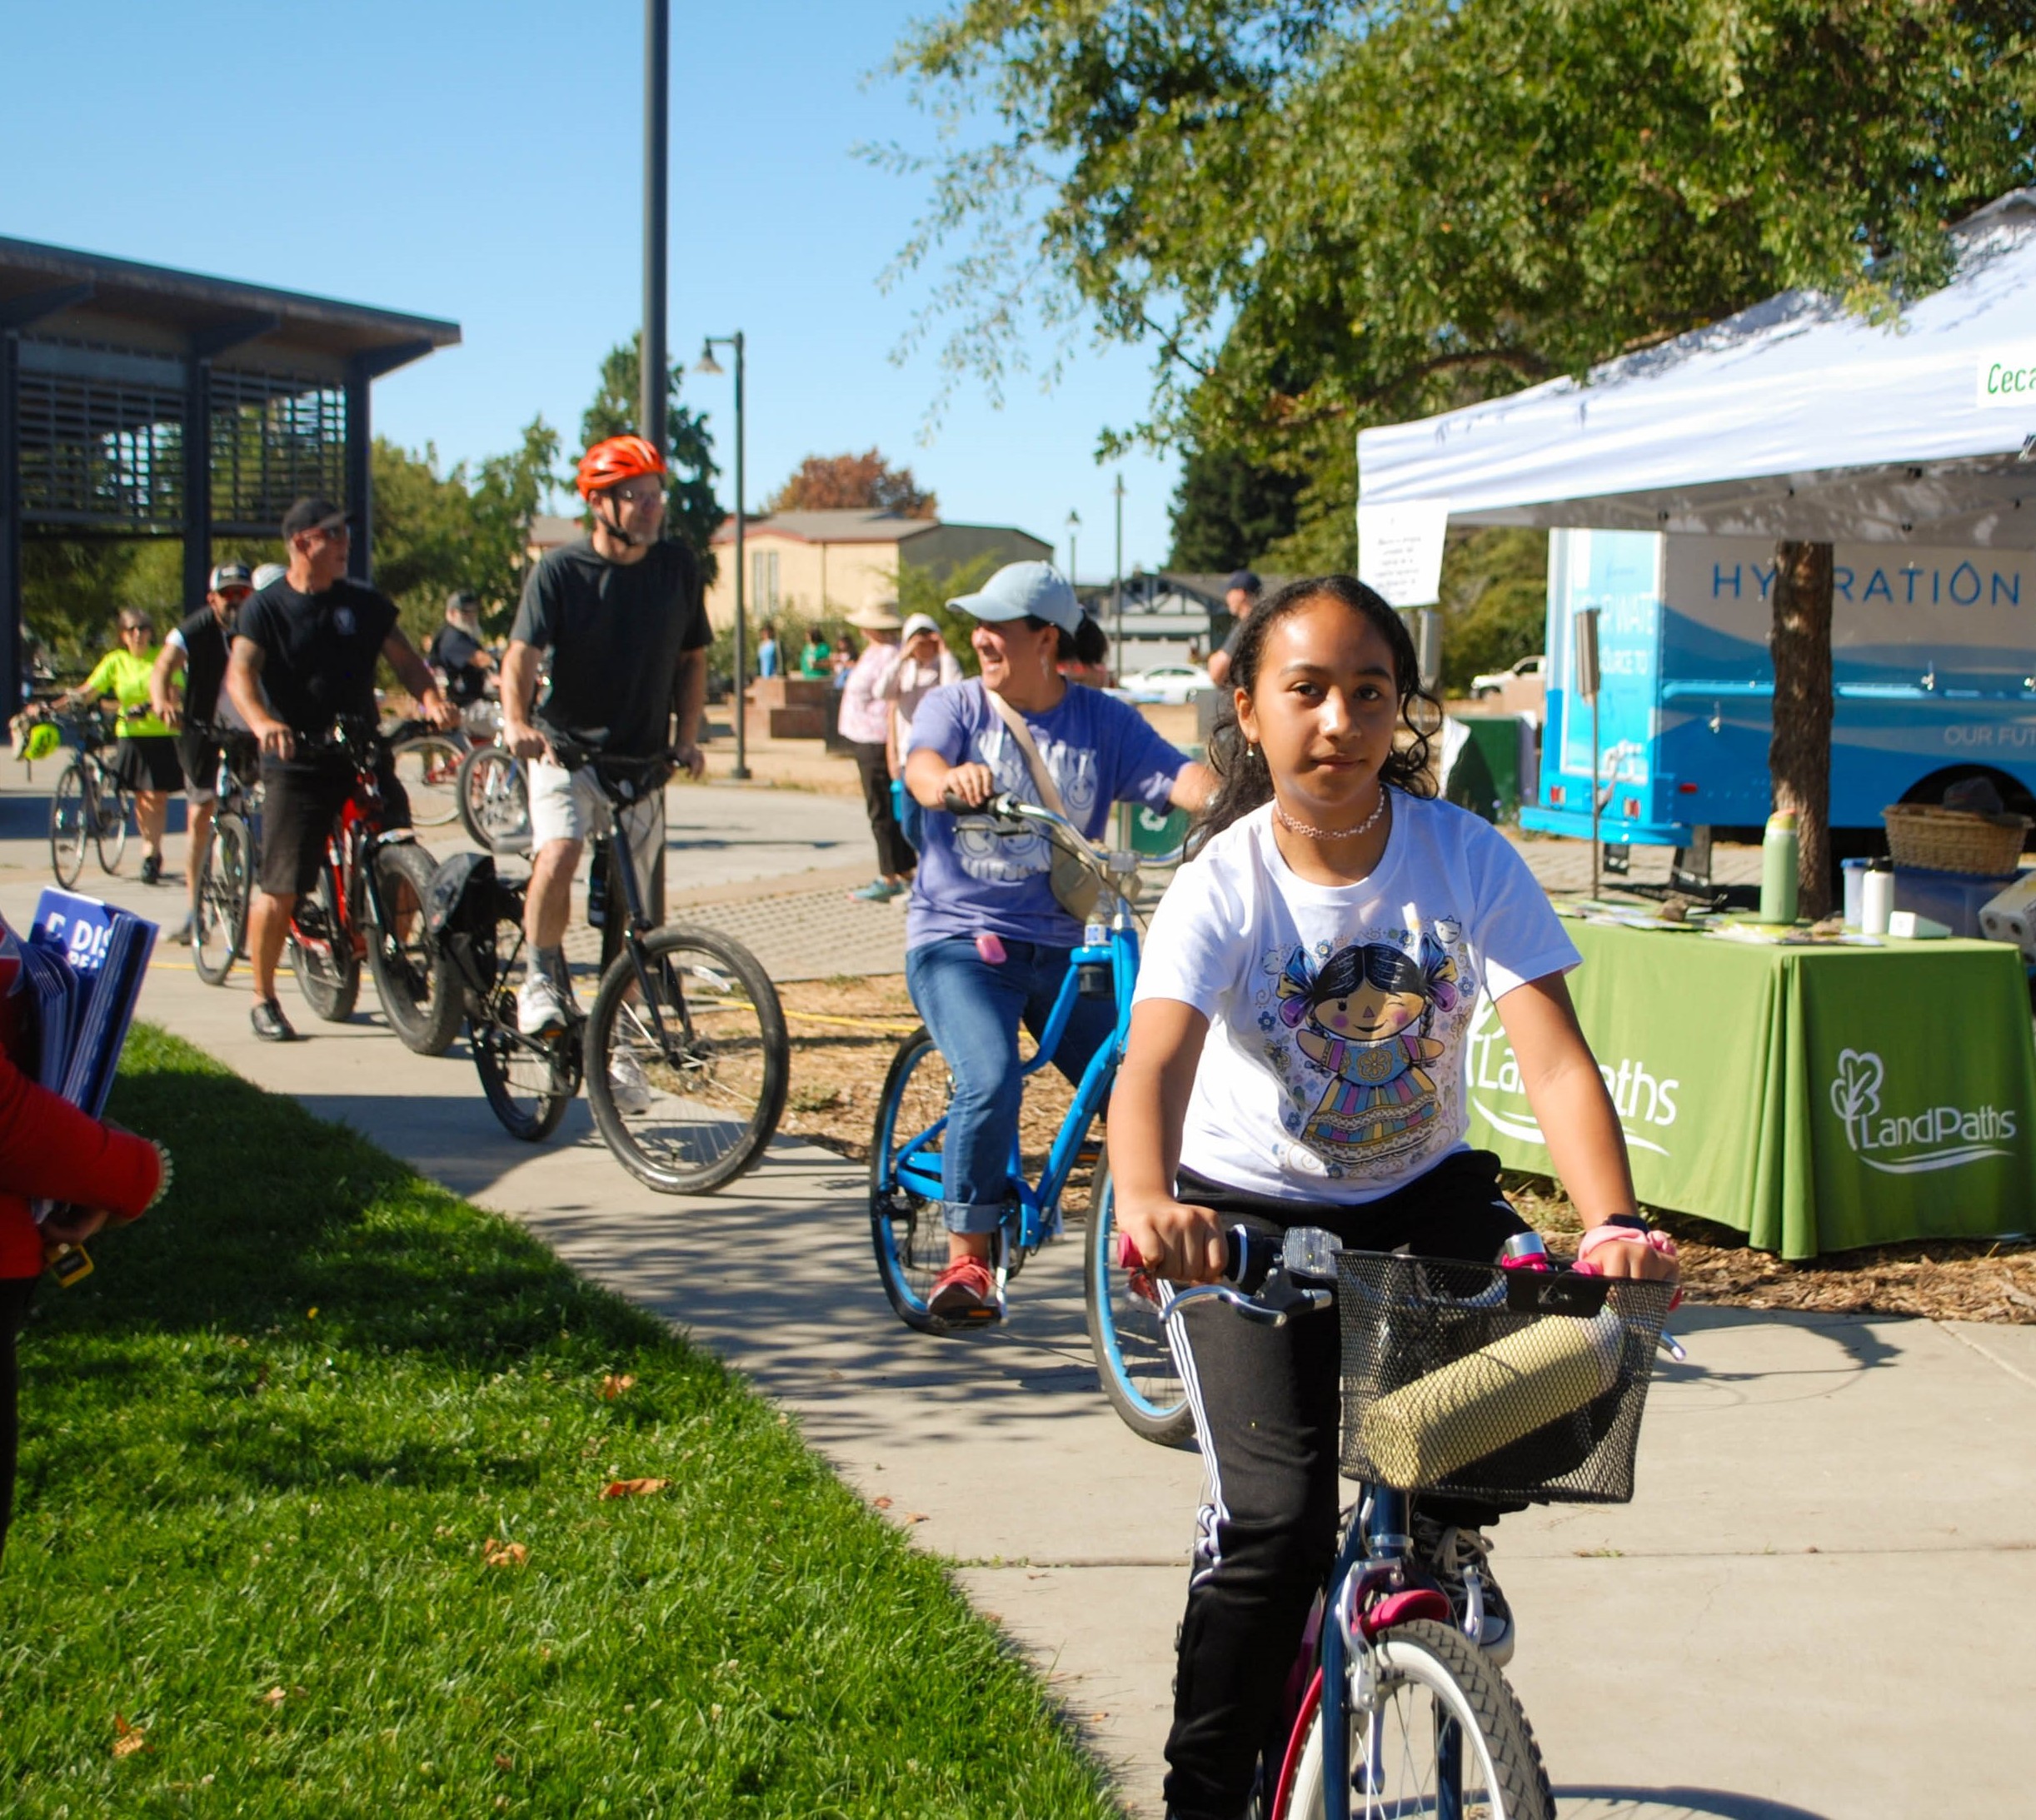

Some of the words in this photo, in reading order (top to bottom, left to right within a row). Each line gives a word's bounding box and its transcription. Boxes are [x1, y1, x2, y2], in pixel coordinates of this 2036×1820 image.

[1713, 560, 2020, 606] HYRATION
[1944, 725, 1992, 747] OUR
[1477, 1034, 1680, 1126] Laaths
[1860, 1104, 2017, 1149] LandPaths
